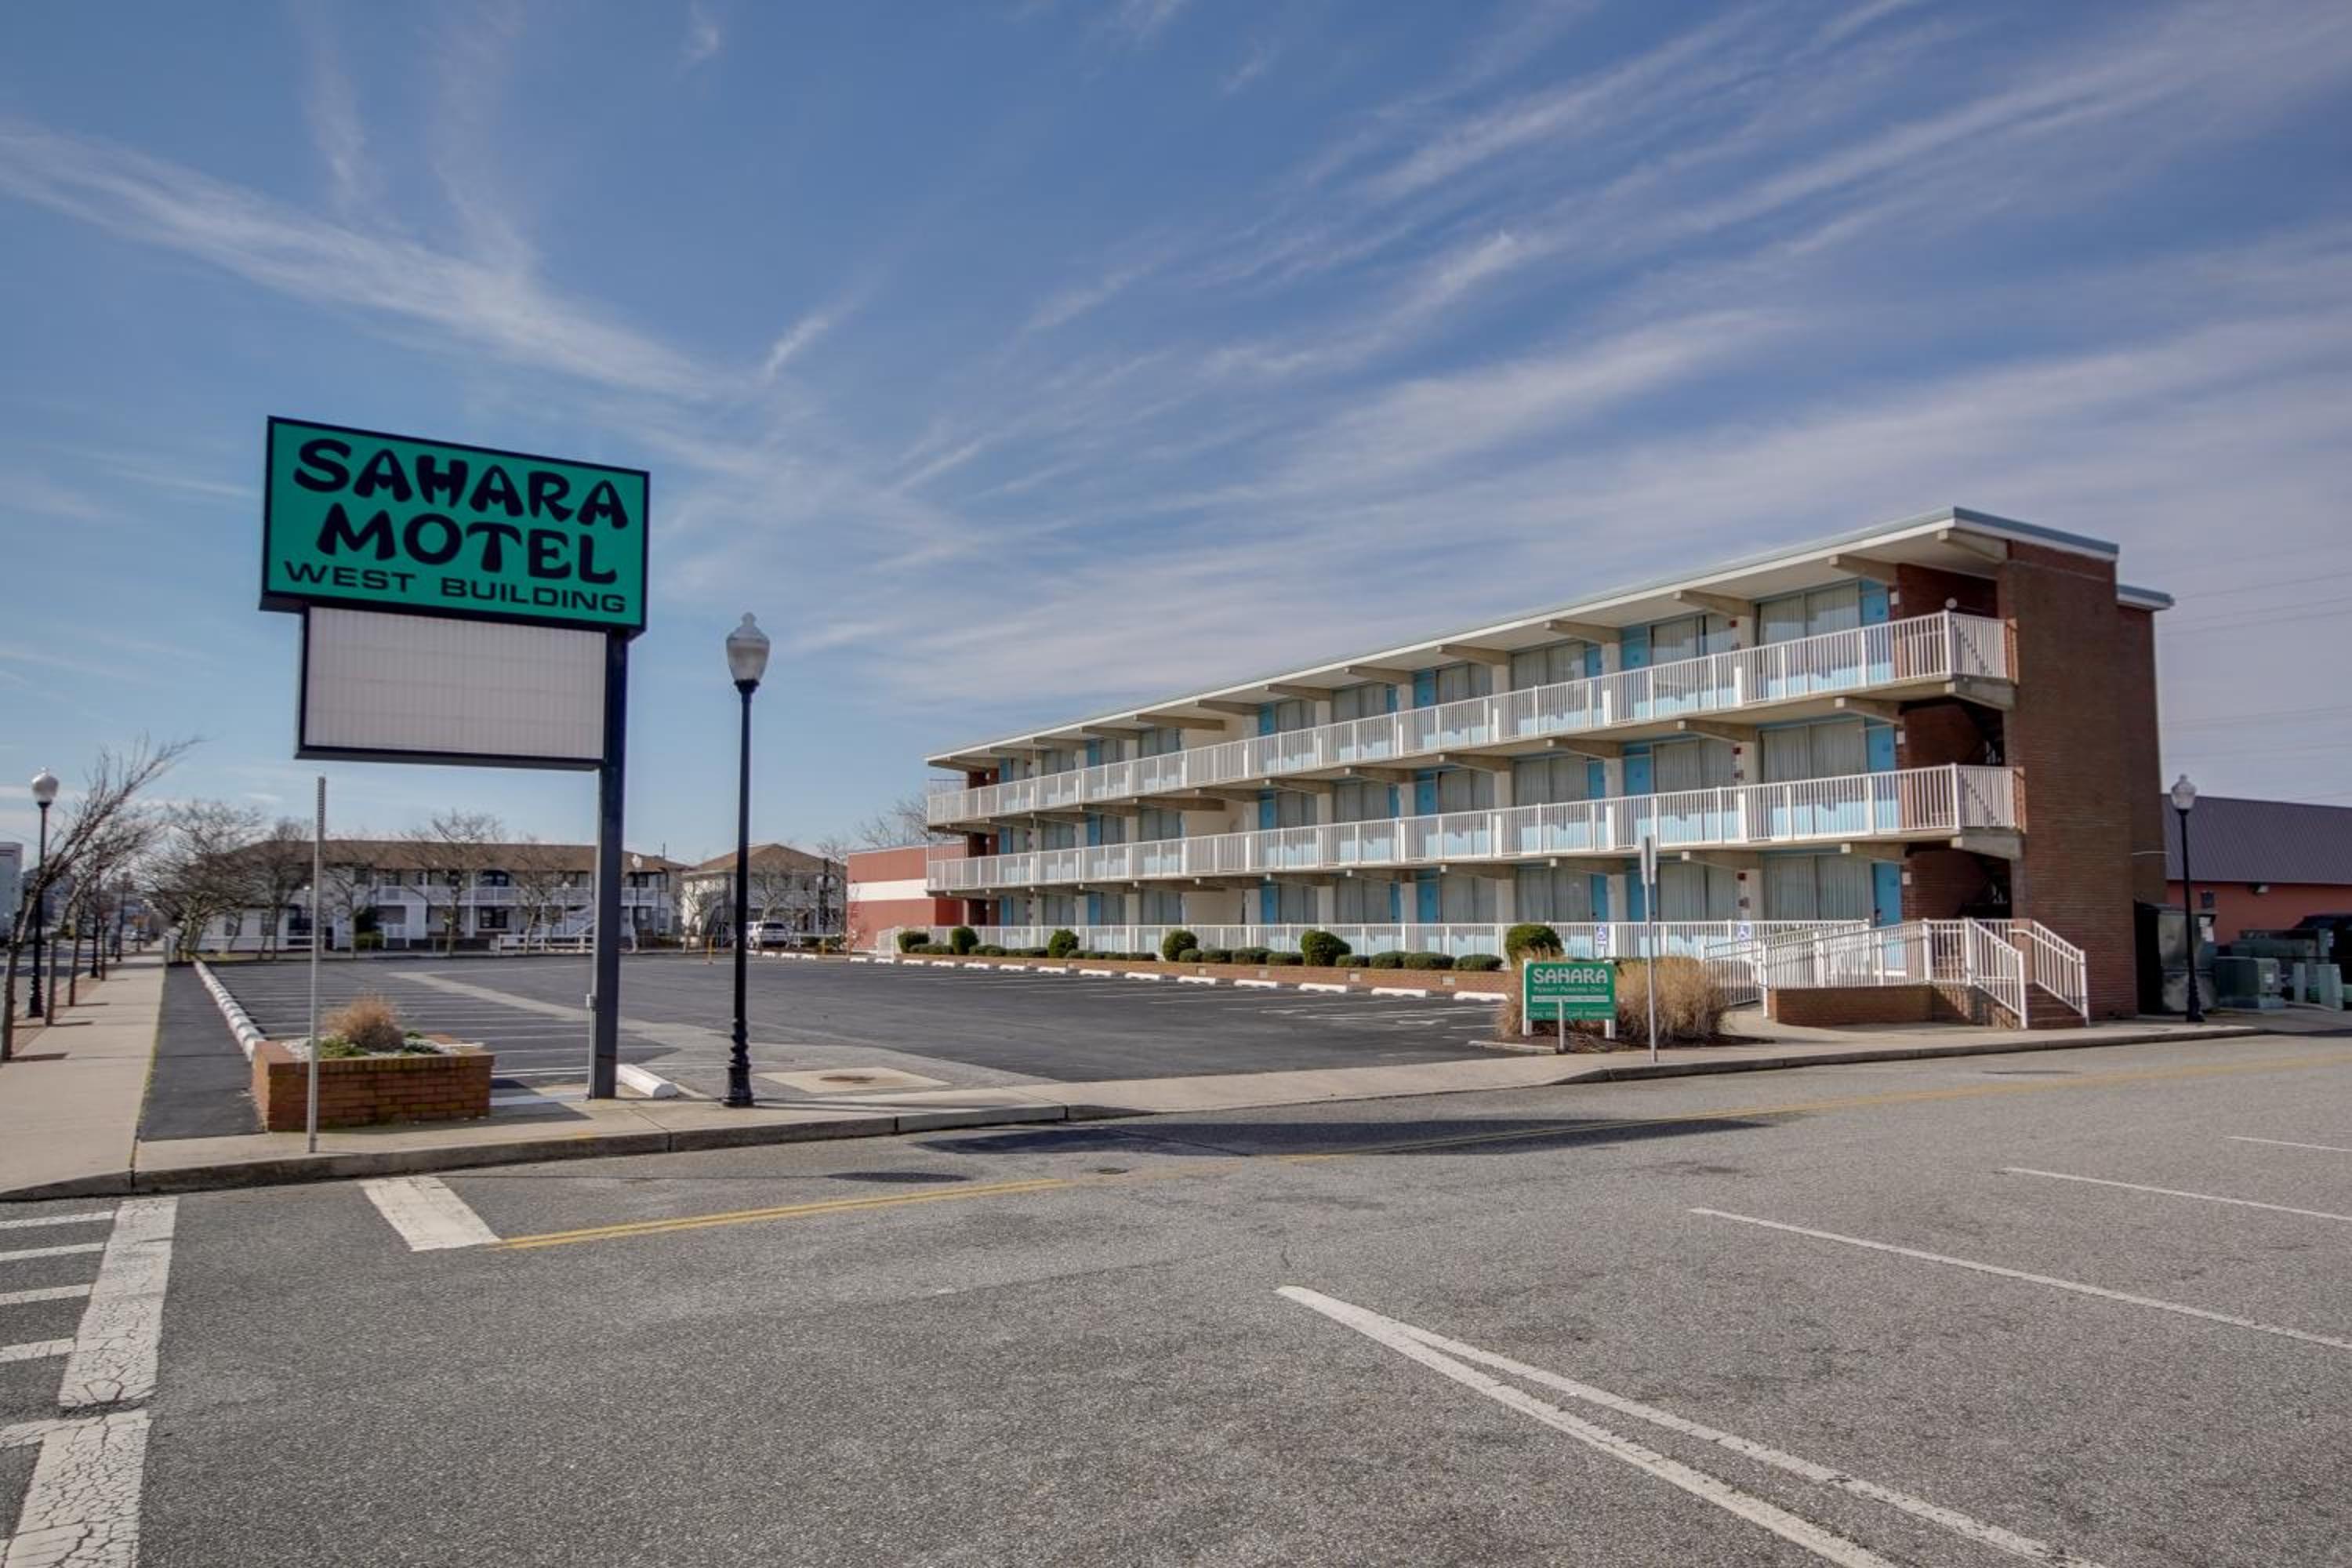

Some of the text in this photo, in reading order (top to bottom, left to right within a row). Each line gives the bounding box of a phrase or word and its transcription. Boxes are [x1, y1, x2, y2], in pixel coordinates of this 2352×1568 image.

[293, 437, 628, 529] SAHARA
[316, 503, 618, 585] MOTEL
[284, 560, 626, 613] WEST BUILDING
[1533, 968, 1608, 984] SAHARA
